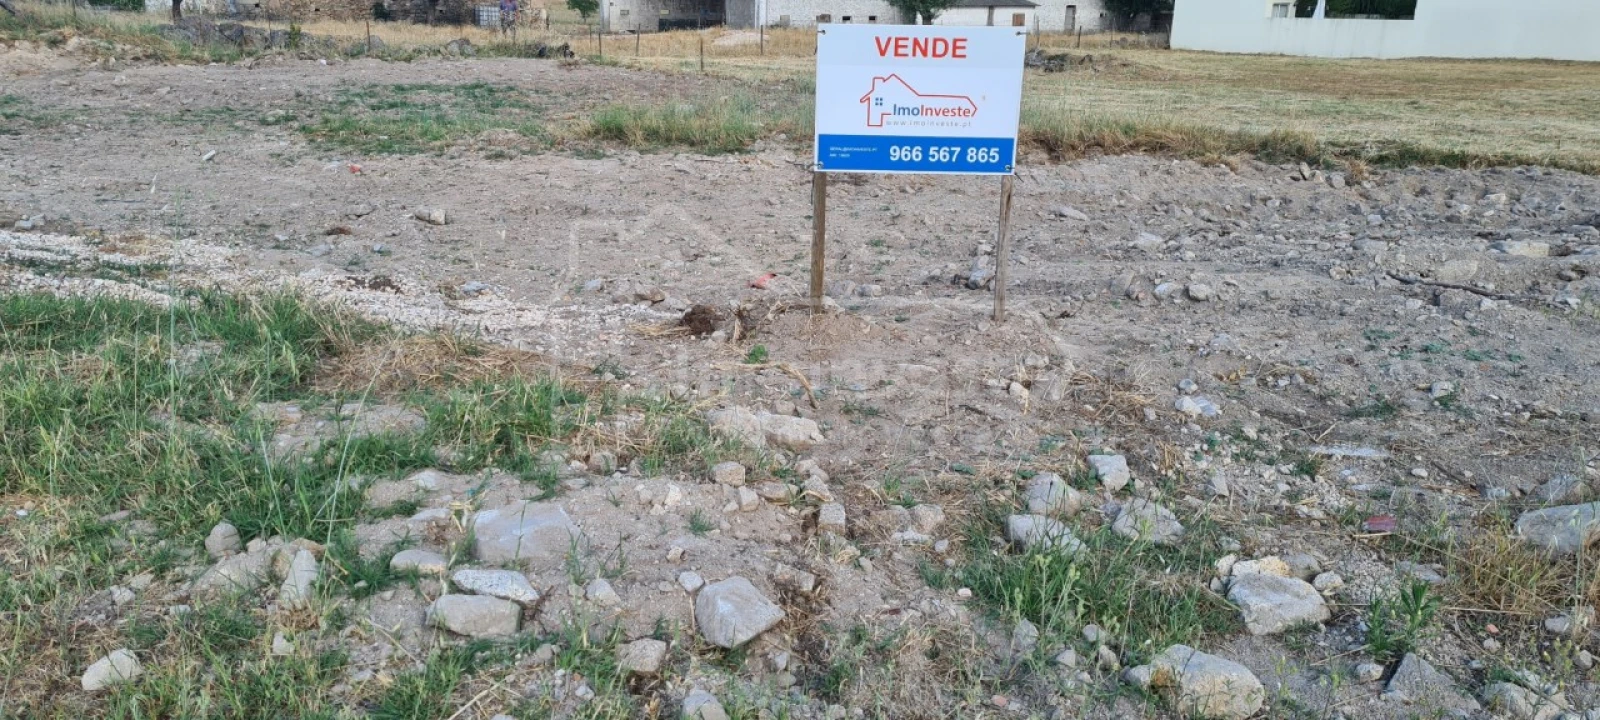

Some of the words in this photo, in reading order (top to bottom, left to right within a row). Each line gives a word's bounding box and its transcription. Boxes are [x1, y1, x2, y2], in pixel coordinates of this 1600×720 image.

[875, 36, 968, 59] VENDE
[893, 103, 971, 117] ImoInveste
[886, 120, 971, 128] www.imoinveste.pt
[889, 145, 922, 161] 966
[928, 146, 961, 162] 567
[966, 147, 1000, 163] 865
